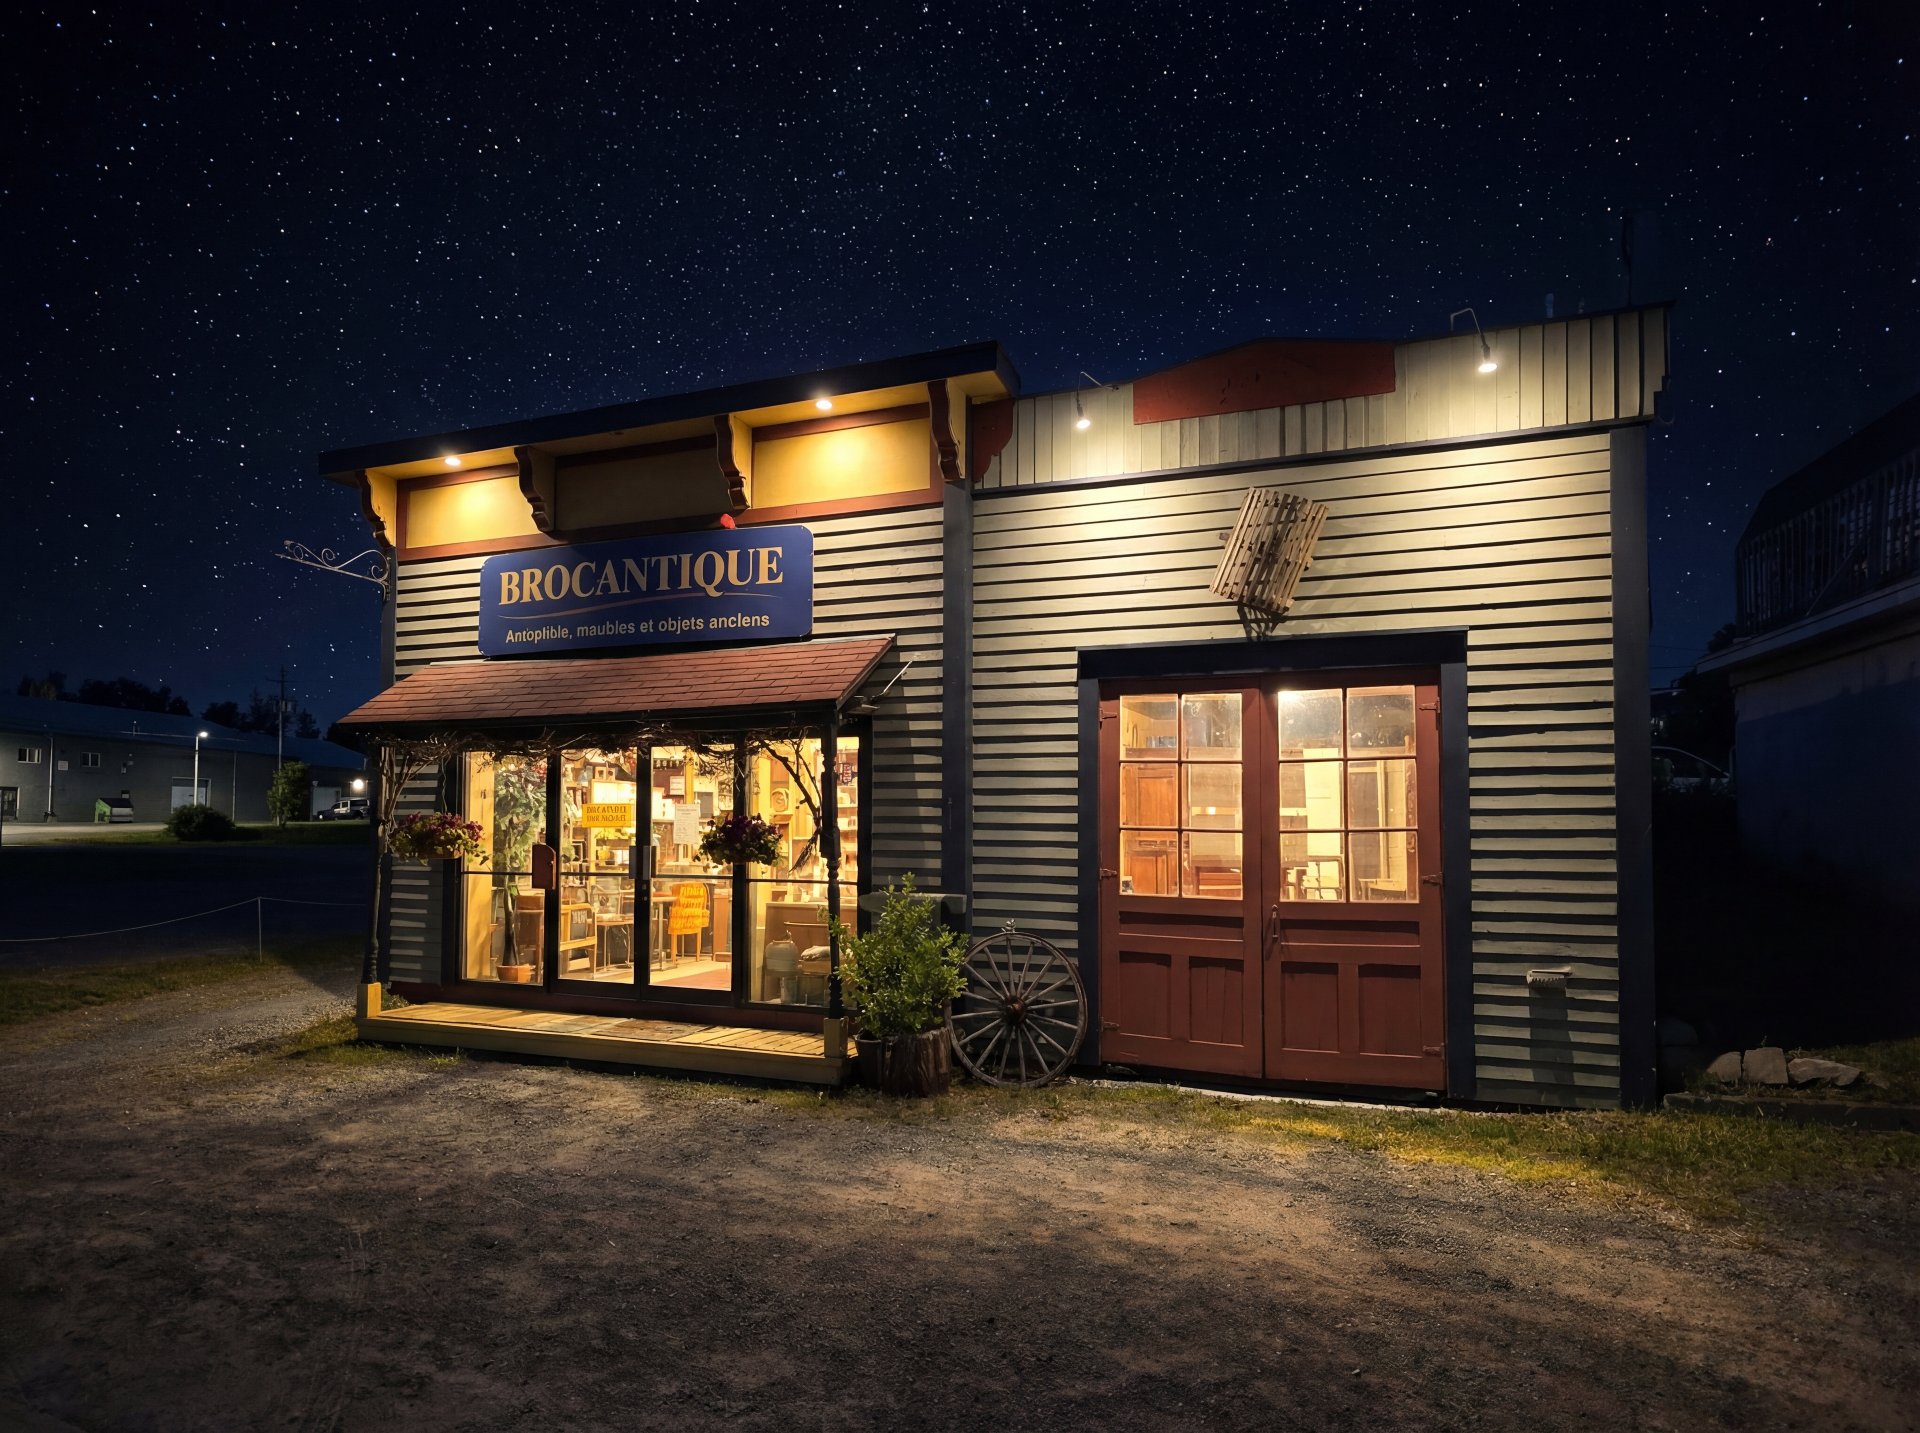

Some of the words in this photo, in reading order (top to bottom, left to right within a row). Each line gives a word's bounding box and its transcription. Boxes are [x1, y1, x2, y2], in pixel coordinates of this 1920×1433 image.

[499, 546, 784, 606] BROCANTIQUE
[640, 619, 654, 632] et
[658, 616, 704, 635] objets
